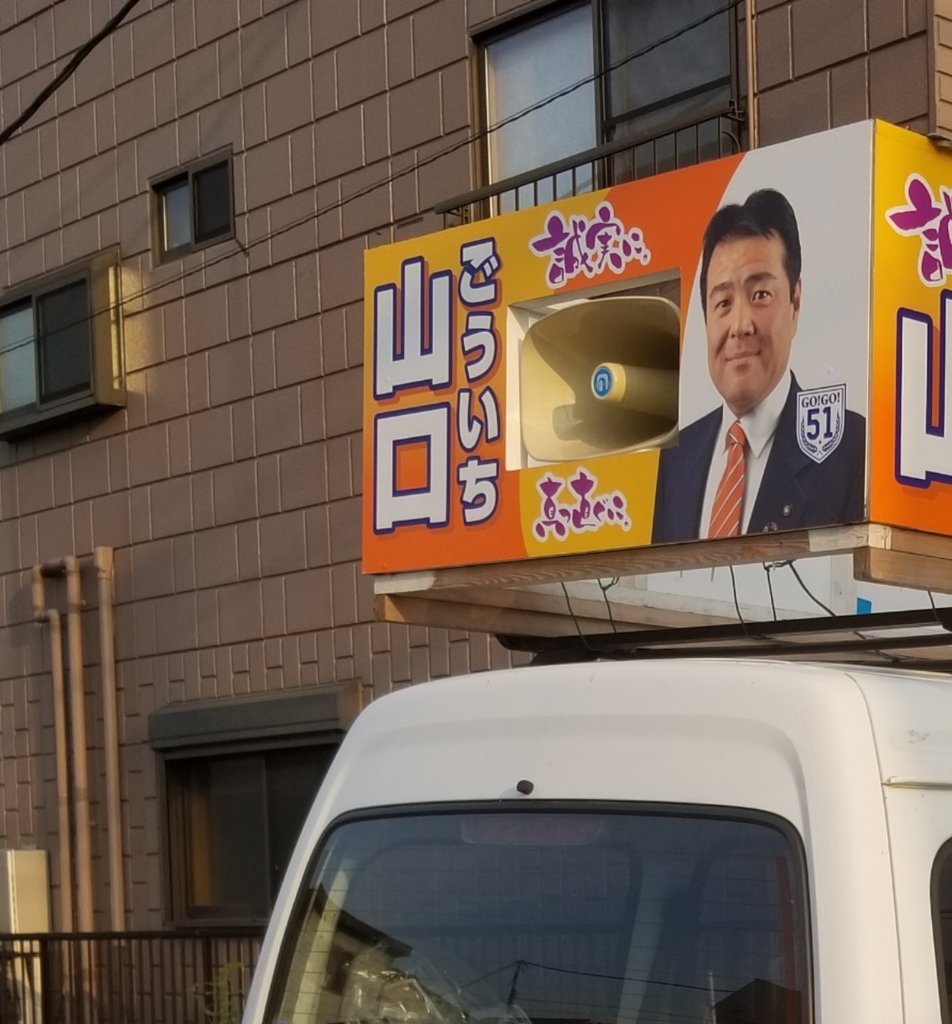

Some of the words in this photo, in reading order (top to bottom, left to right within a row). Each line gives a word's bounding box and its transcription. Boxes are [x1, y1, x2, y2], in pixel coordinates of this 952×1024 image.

[374, 256, 453, 535] 山口
[458, 237, 501, 526] ごういち
[807, 406, 833, 440] 51
